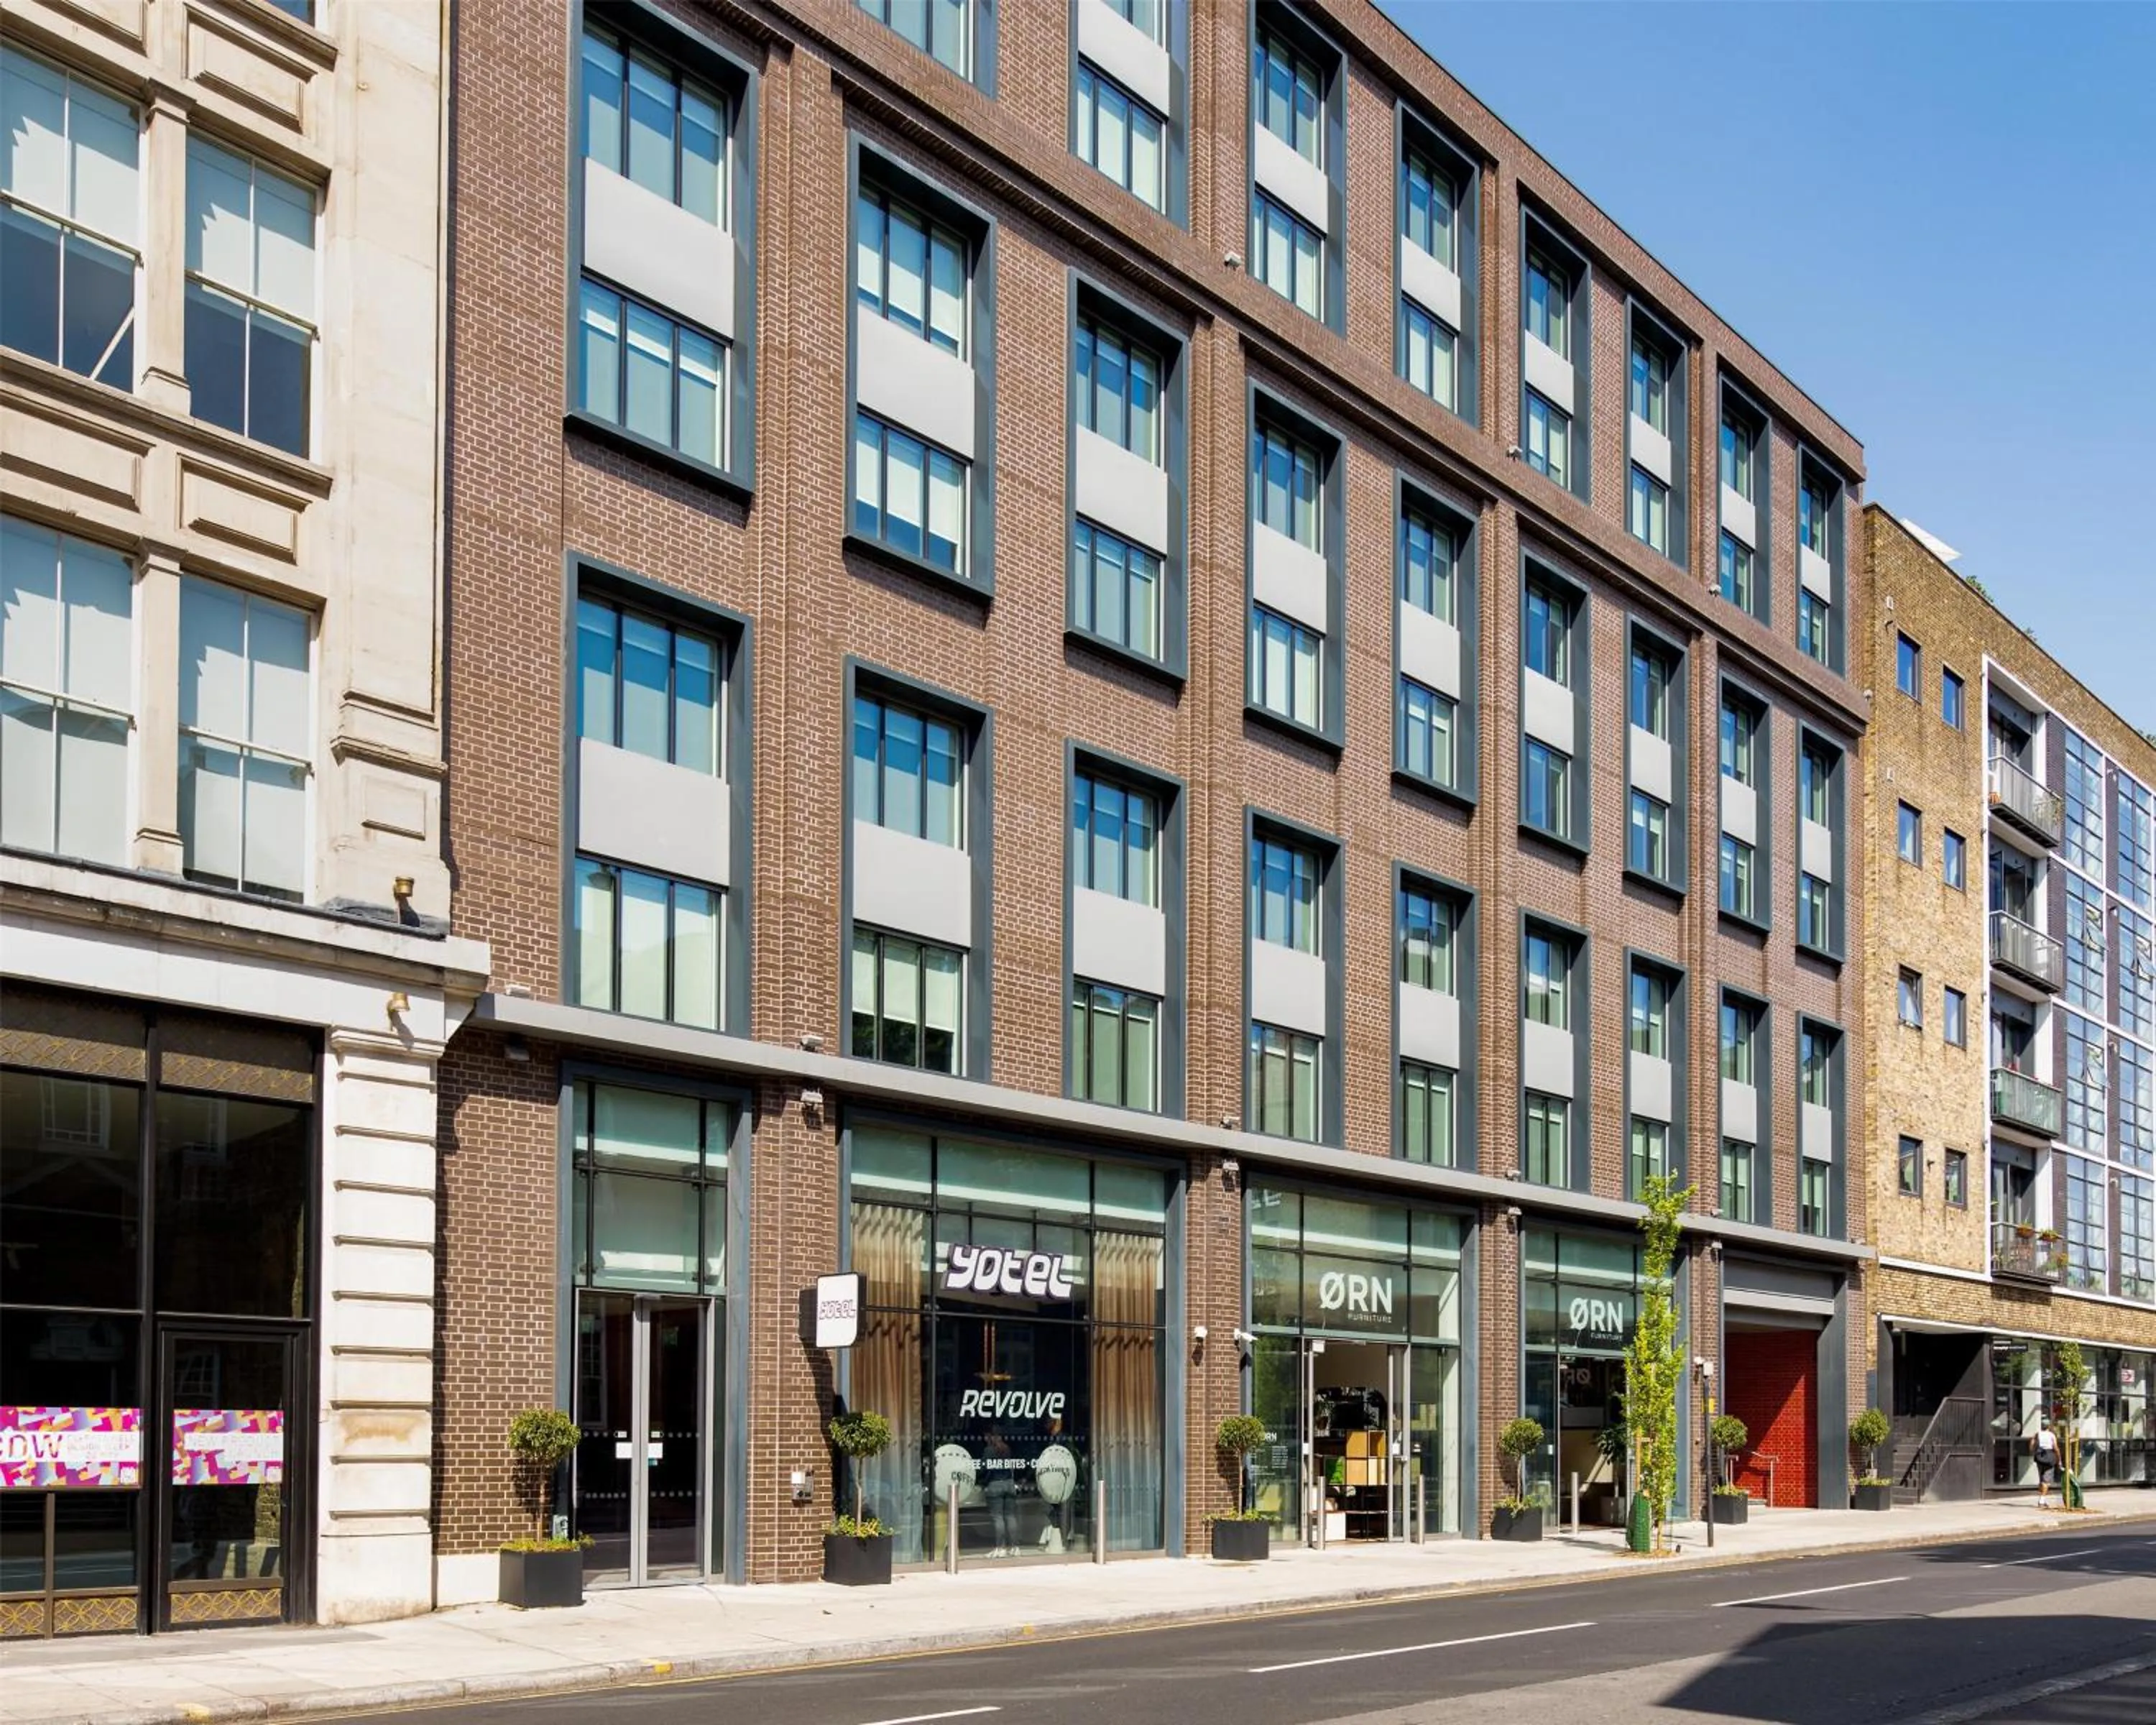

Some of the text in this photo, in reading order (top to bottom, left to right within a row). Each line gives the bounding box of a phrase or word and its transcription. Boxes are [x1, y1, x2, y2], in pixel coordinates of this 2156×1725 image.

[1348, 1313, 1392, 1323] FURNITURE
[0, 1434, 63, 1458] DW
[986, 1458, 1003, 1469] BAR
[1005, 1458, 1026, 1468] BITES
